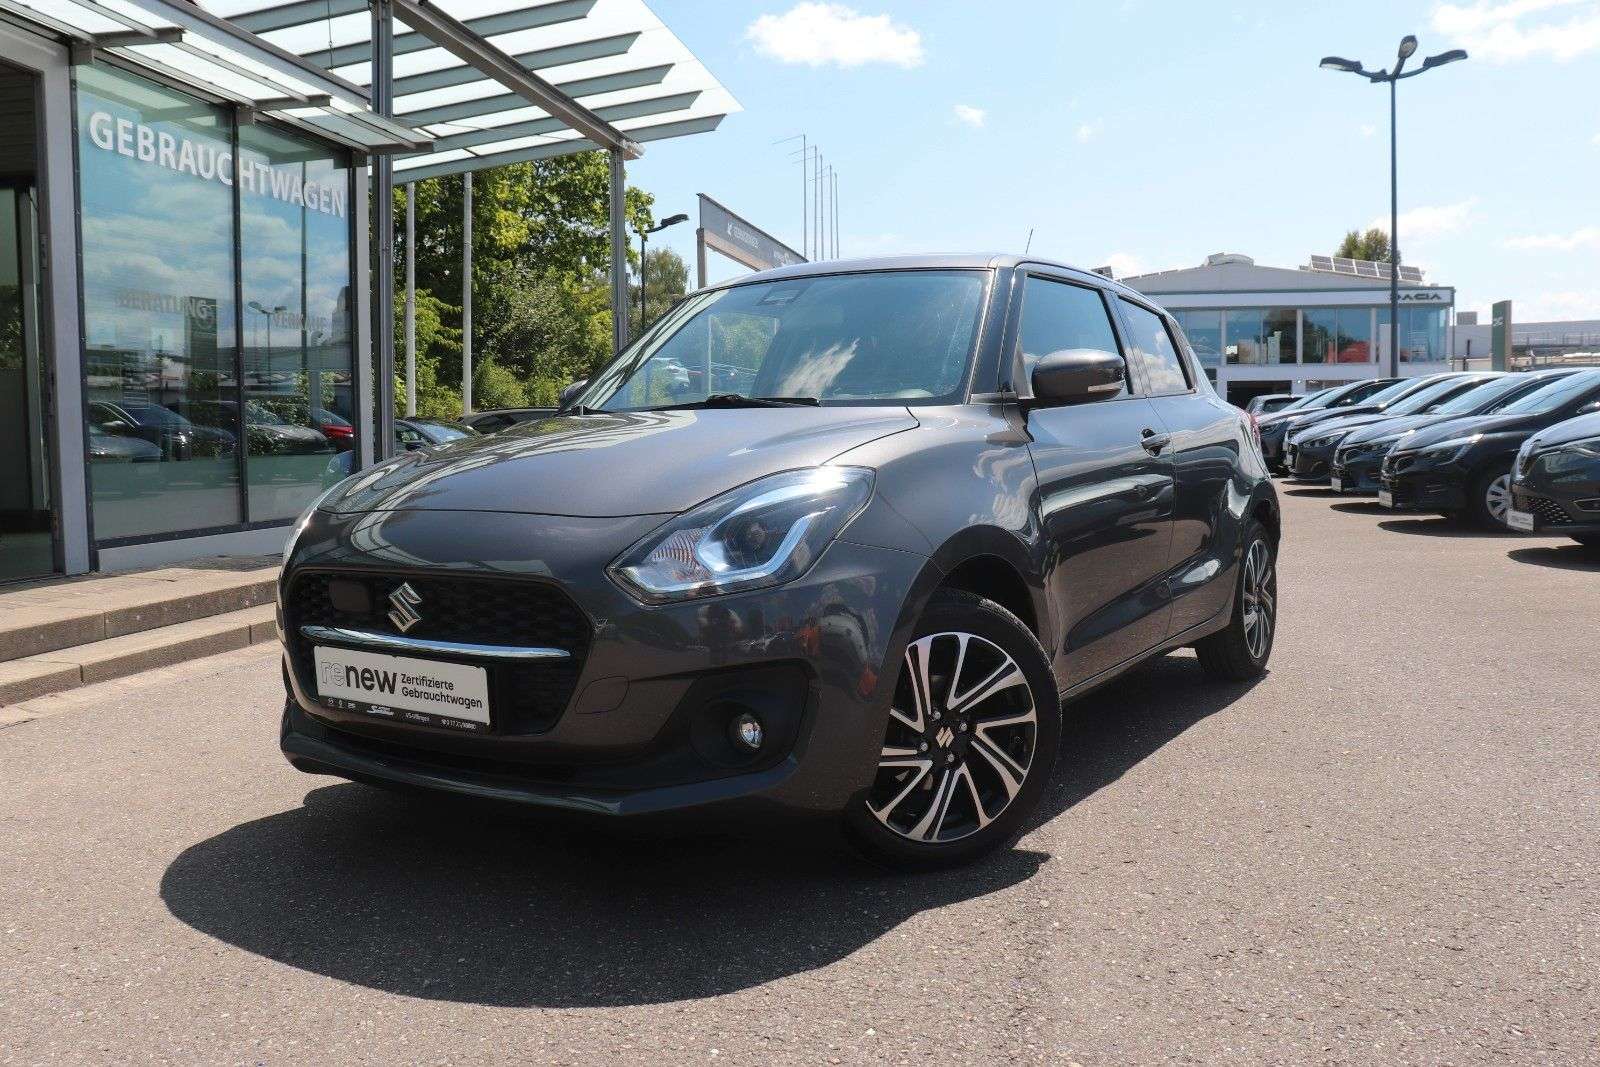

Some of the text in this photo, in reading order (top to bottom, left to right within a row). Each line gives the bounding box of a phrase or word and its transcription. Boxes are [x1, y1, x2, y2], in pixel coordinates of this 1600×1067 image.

[89, 111, 345, 218] GEBRAUCHTWAGEN
[1390, 293, 1442, 301] ACIA
[321, 661, 398, 694] renew
[401, 673, 454, 691] Zertifizierte
[401, 686, 483, 709] Gebrauchtwagen
